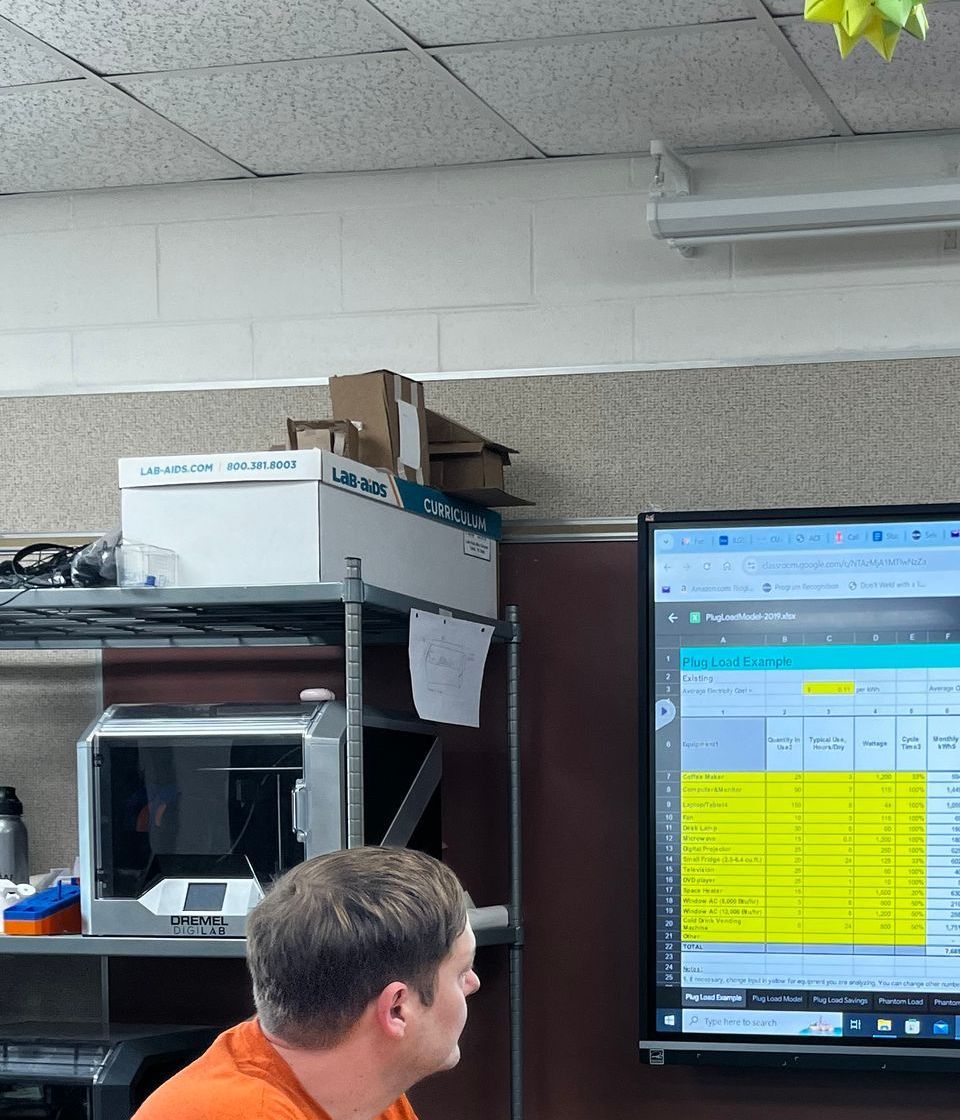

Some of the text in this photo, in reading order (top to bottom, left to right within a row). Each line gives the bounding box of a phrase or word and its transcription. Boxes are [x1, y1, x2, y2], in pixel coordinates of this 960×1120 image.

[140, 460, 297, 476] LAB-AIDS.COM 800.381.8003
[424, 498, 487, 531] CURRICULUM
[705, 612, 797, 623] PlugLoadModel-2019.xlsx
[682, 655, 792, 669] Plug Load Example
[682, 674, 714, 682] Existing
[809, 736, 832, 744] Typical
[171, 915, 229, 926] DREMEL
[173, 926, 226, 935] DIGILAB
[685, 993, 743, 1003] Plug Load Example
[752, 995, 766, 1003] Plug
[783, 995, 803, 1003] Model
[812, 996, 827, 1004] Plug
[844, 997, 869, 1005] Savings
[703, 1017, 722, 1027] Type
[751, 1019, 777, 1027] search
